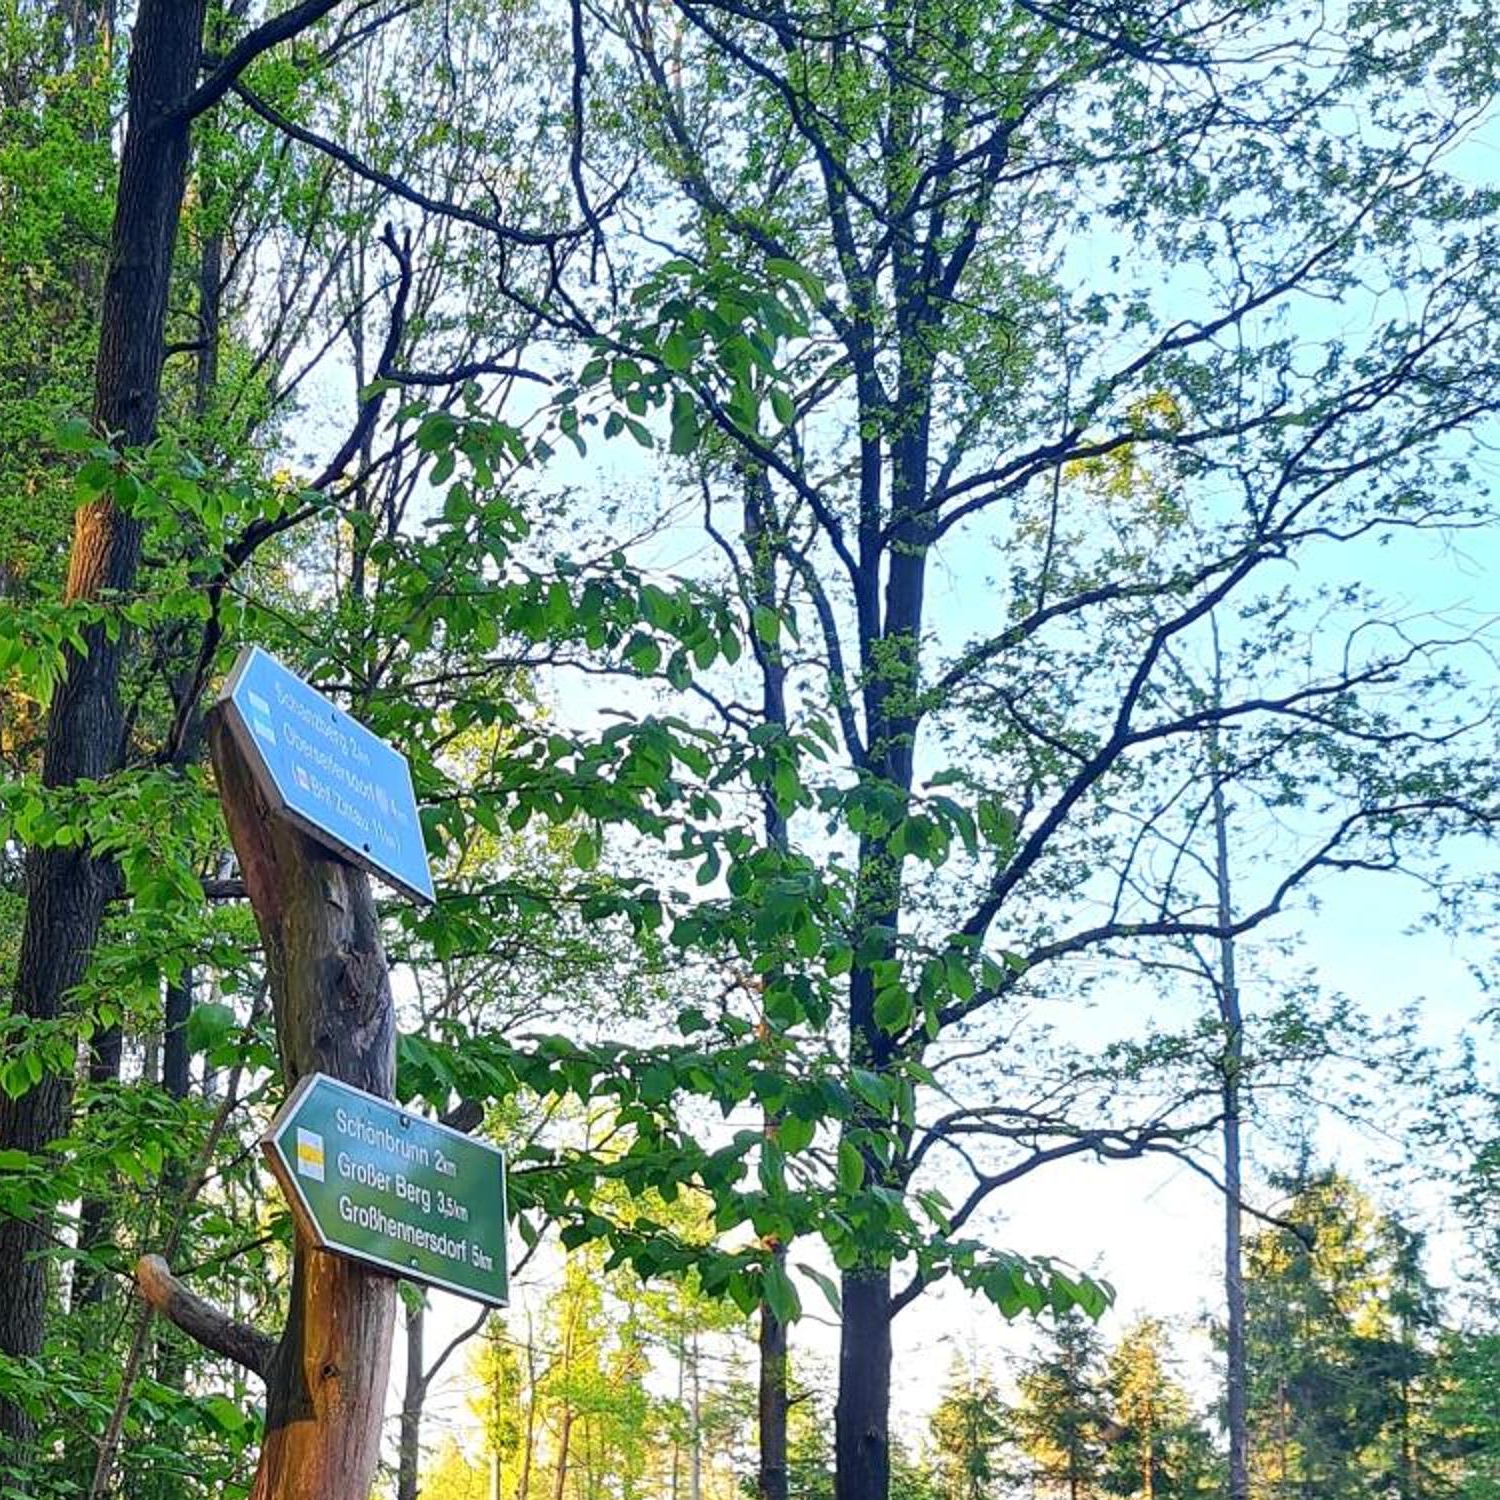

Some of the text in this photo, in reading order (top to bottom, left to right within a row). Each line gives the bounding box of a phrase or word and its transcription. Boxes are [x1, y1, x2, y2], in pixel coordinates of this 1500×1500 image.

[335, 1107, 457, 1178] Schönbrunn 2km
[337, 1152, 390, 1193] Großer
[395, 1173, 431, 1214] Berg
[339, 1195, 494, 1271] Großhennersdorf 5km
